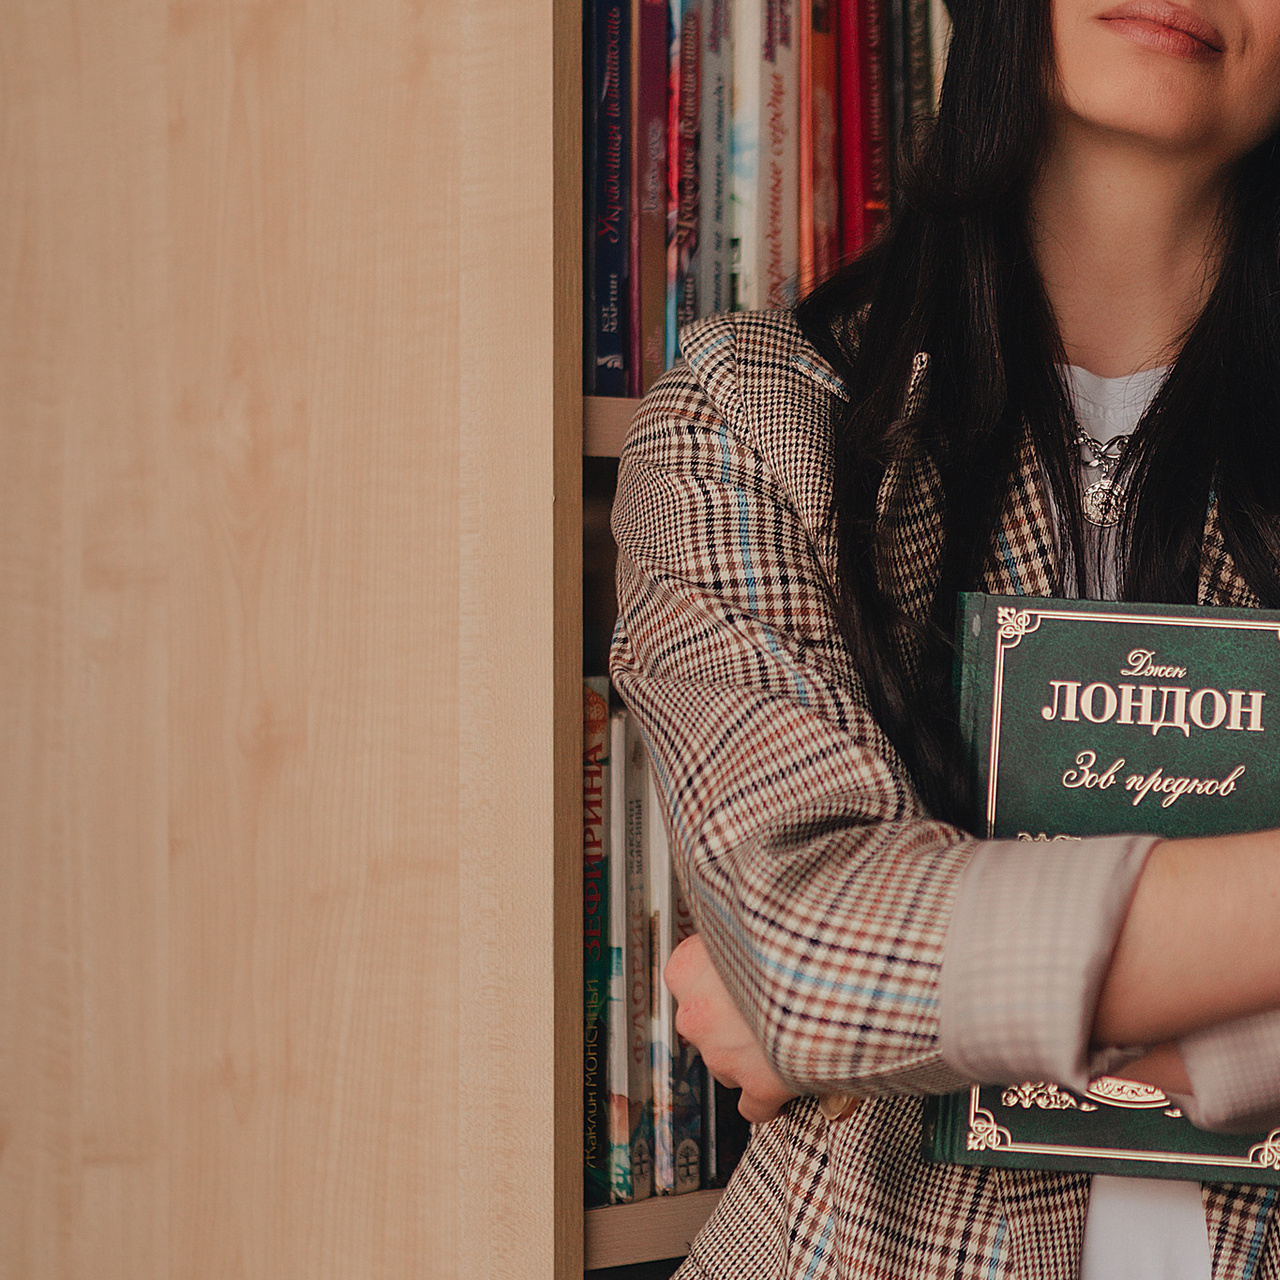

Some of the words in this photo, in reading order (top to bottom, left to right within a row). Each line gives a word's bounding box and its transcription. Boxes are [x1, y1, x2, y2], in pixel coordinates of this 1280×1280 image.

[603, 7, 622, 119] невинность
[768, 74, 788, 156] сердца
[598, 126, 621, 246] Украденная
[676, 141, 699, 248] Чудесное
[600, 303, 611, 333] КЭТ
[608, 274, 620, 333] МАРТИН
[684, 277, 695, 323] АРТИН
[1121, 649, 1187, 678] Джек
[1041, 680, 1266, 737] ЛОНДОН
[1063, 751, 1125, 790] Зов
[1126, 765, 1246, 808] предков
[584, 741, 603, 963] ЗЕФИРИНА
[629, 800, 637, 874] ЖАКЛИН
[636, 800, 644, 874] МОНСИНЬИ
[632, 898, 647, 1064] ФЛОРИС
[586, 978, 598, 1086] МОНСИНЬИ
[585, 1089, 600, 1170] Жаклин
